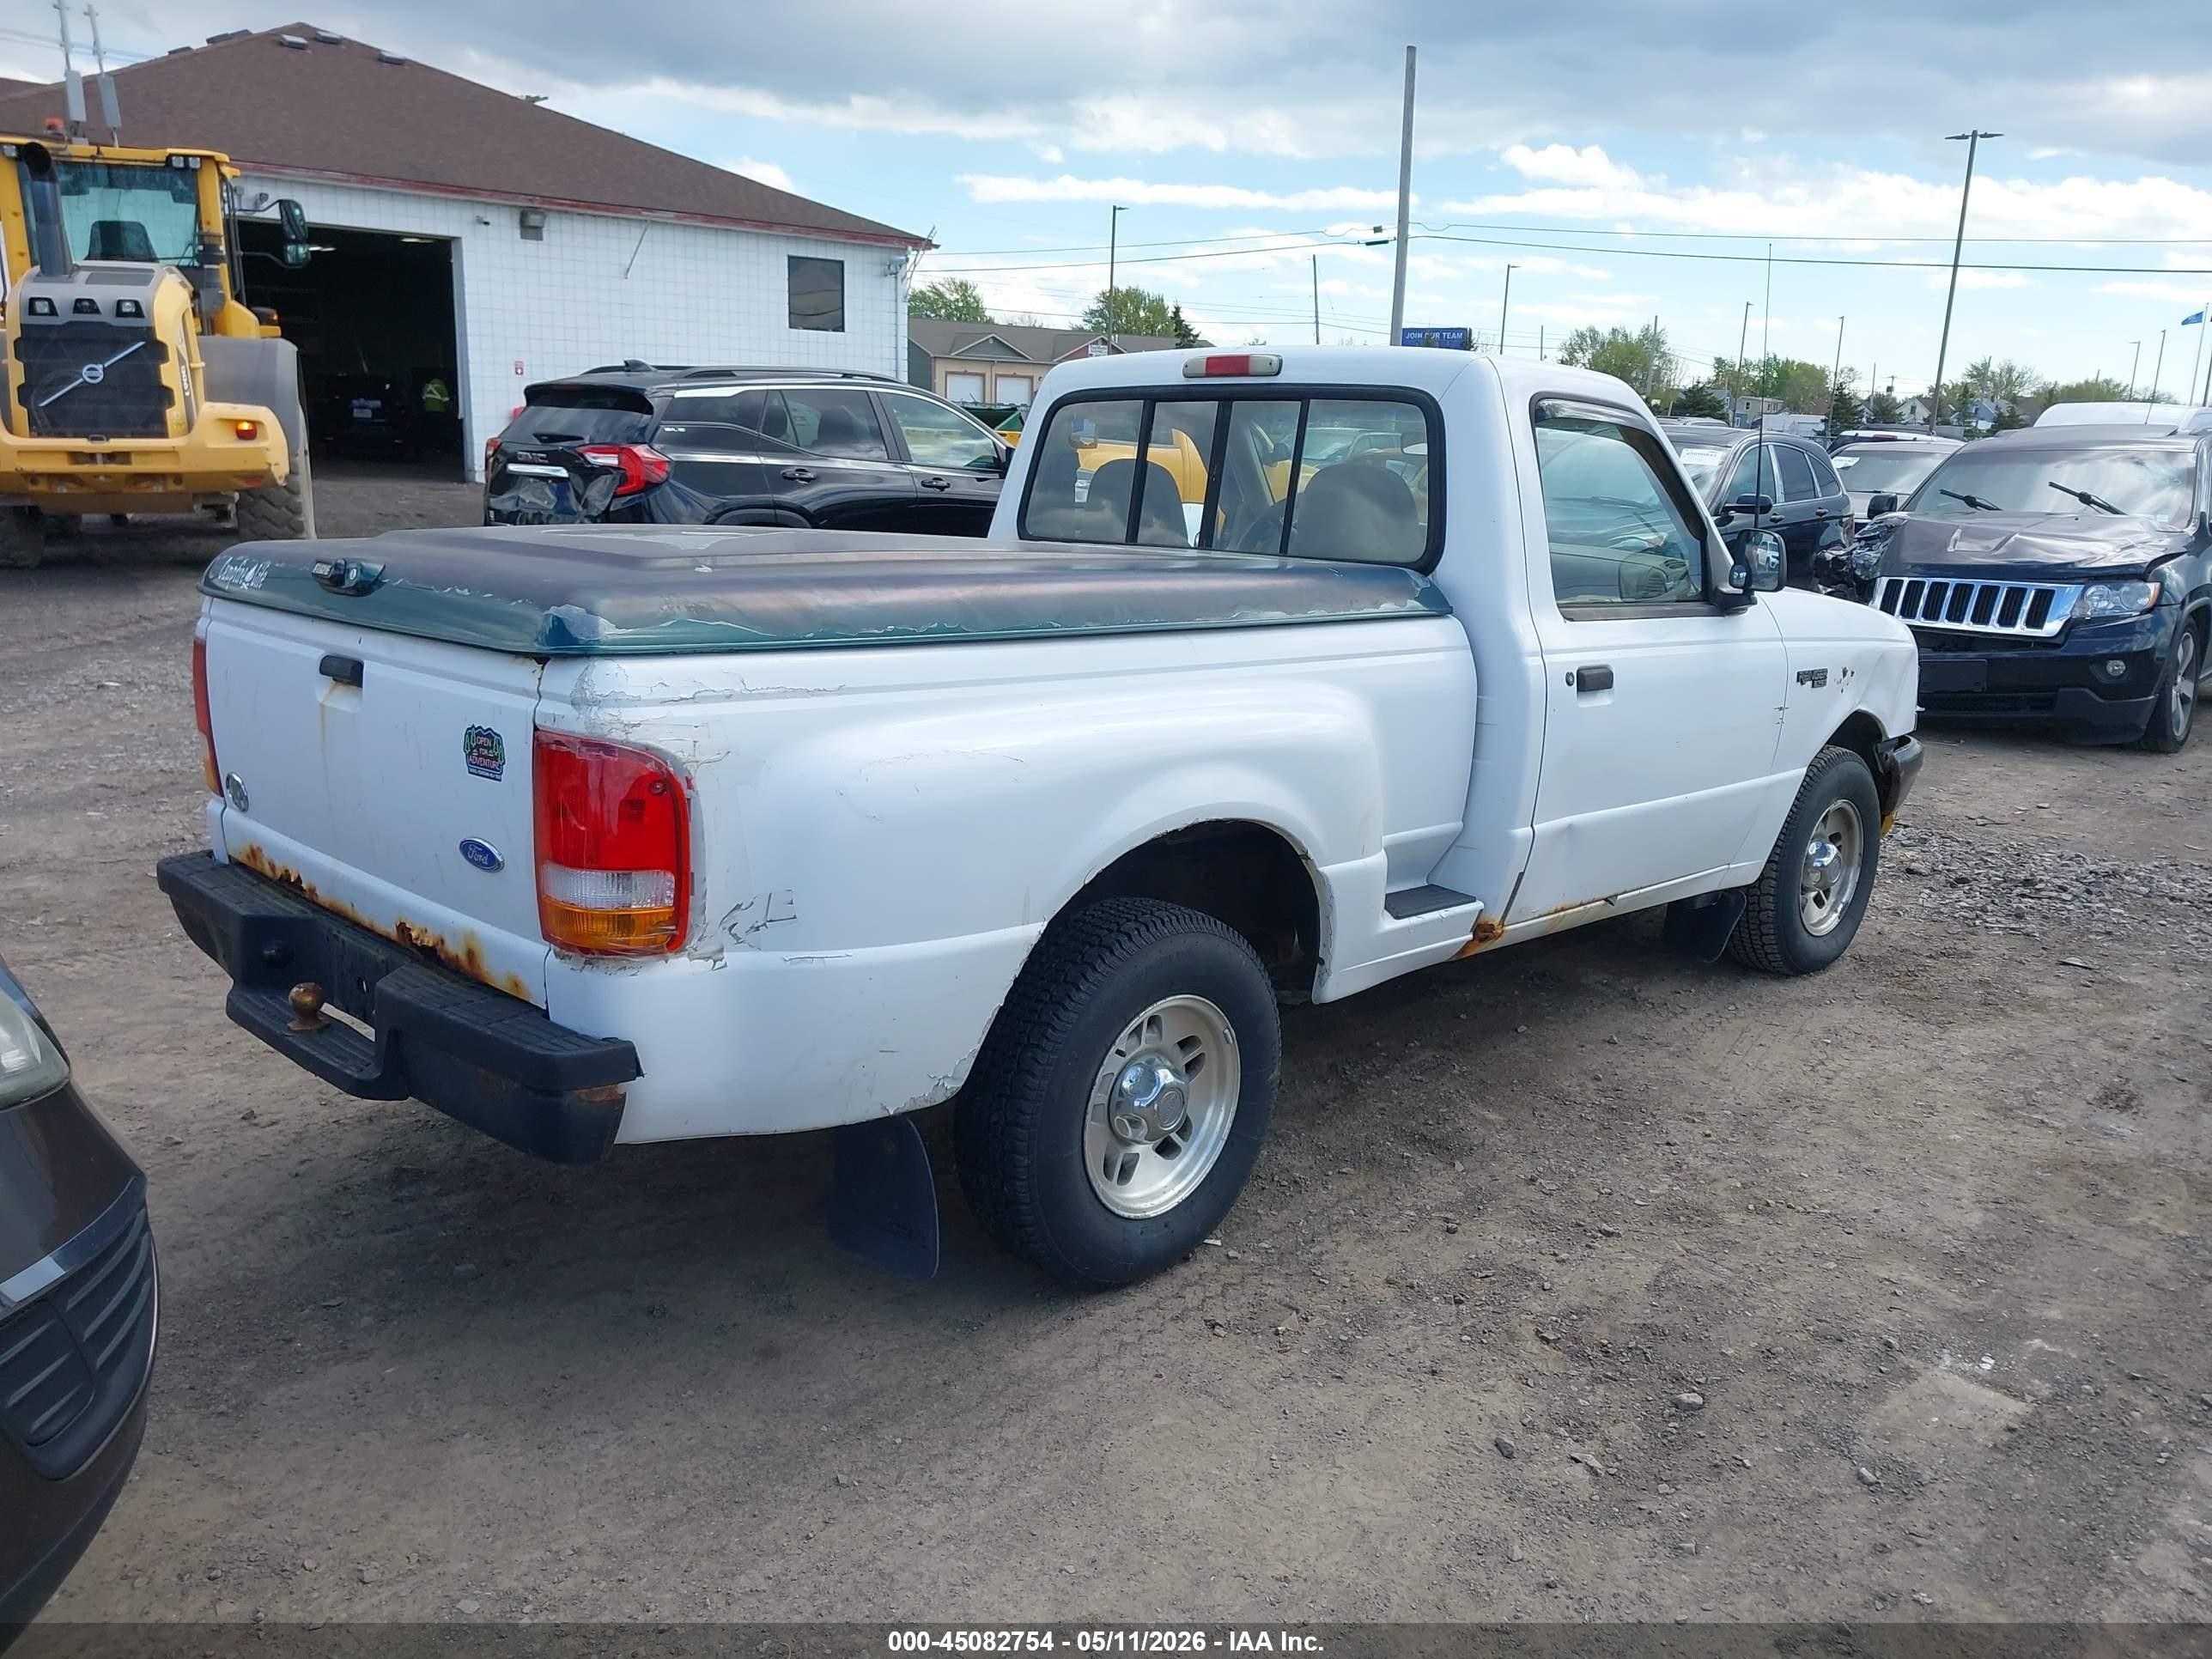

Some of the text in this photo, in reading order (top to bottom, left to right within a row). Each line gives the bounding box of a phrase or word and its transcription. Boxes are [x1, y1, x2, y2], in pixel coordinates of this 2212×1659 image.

[1406, 331, 1423, 340] JOIN
[1443, 331, 1464, 340] TEAM
[469, 755, 501, 770] ADVENTURE
[468, 844, 489, 865] Ford
